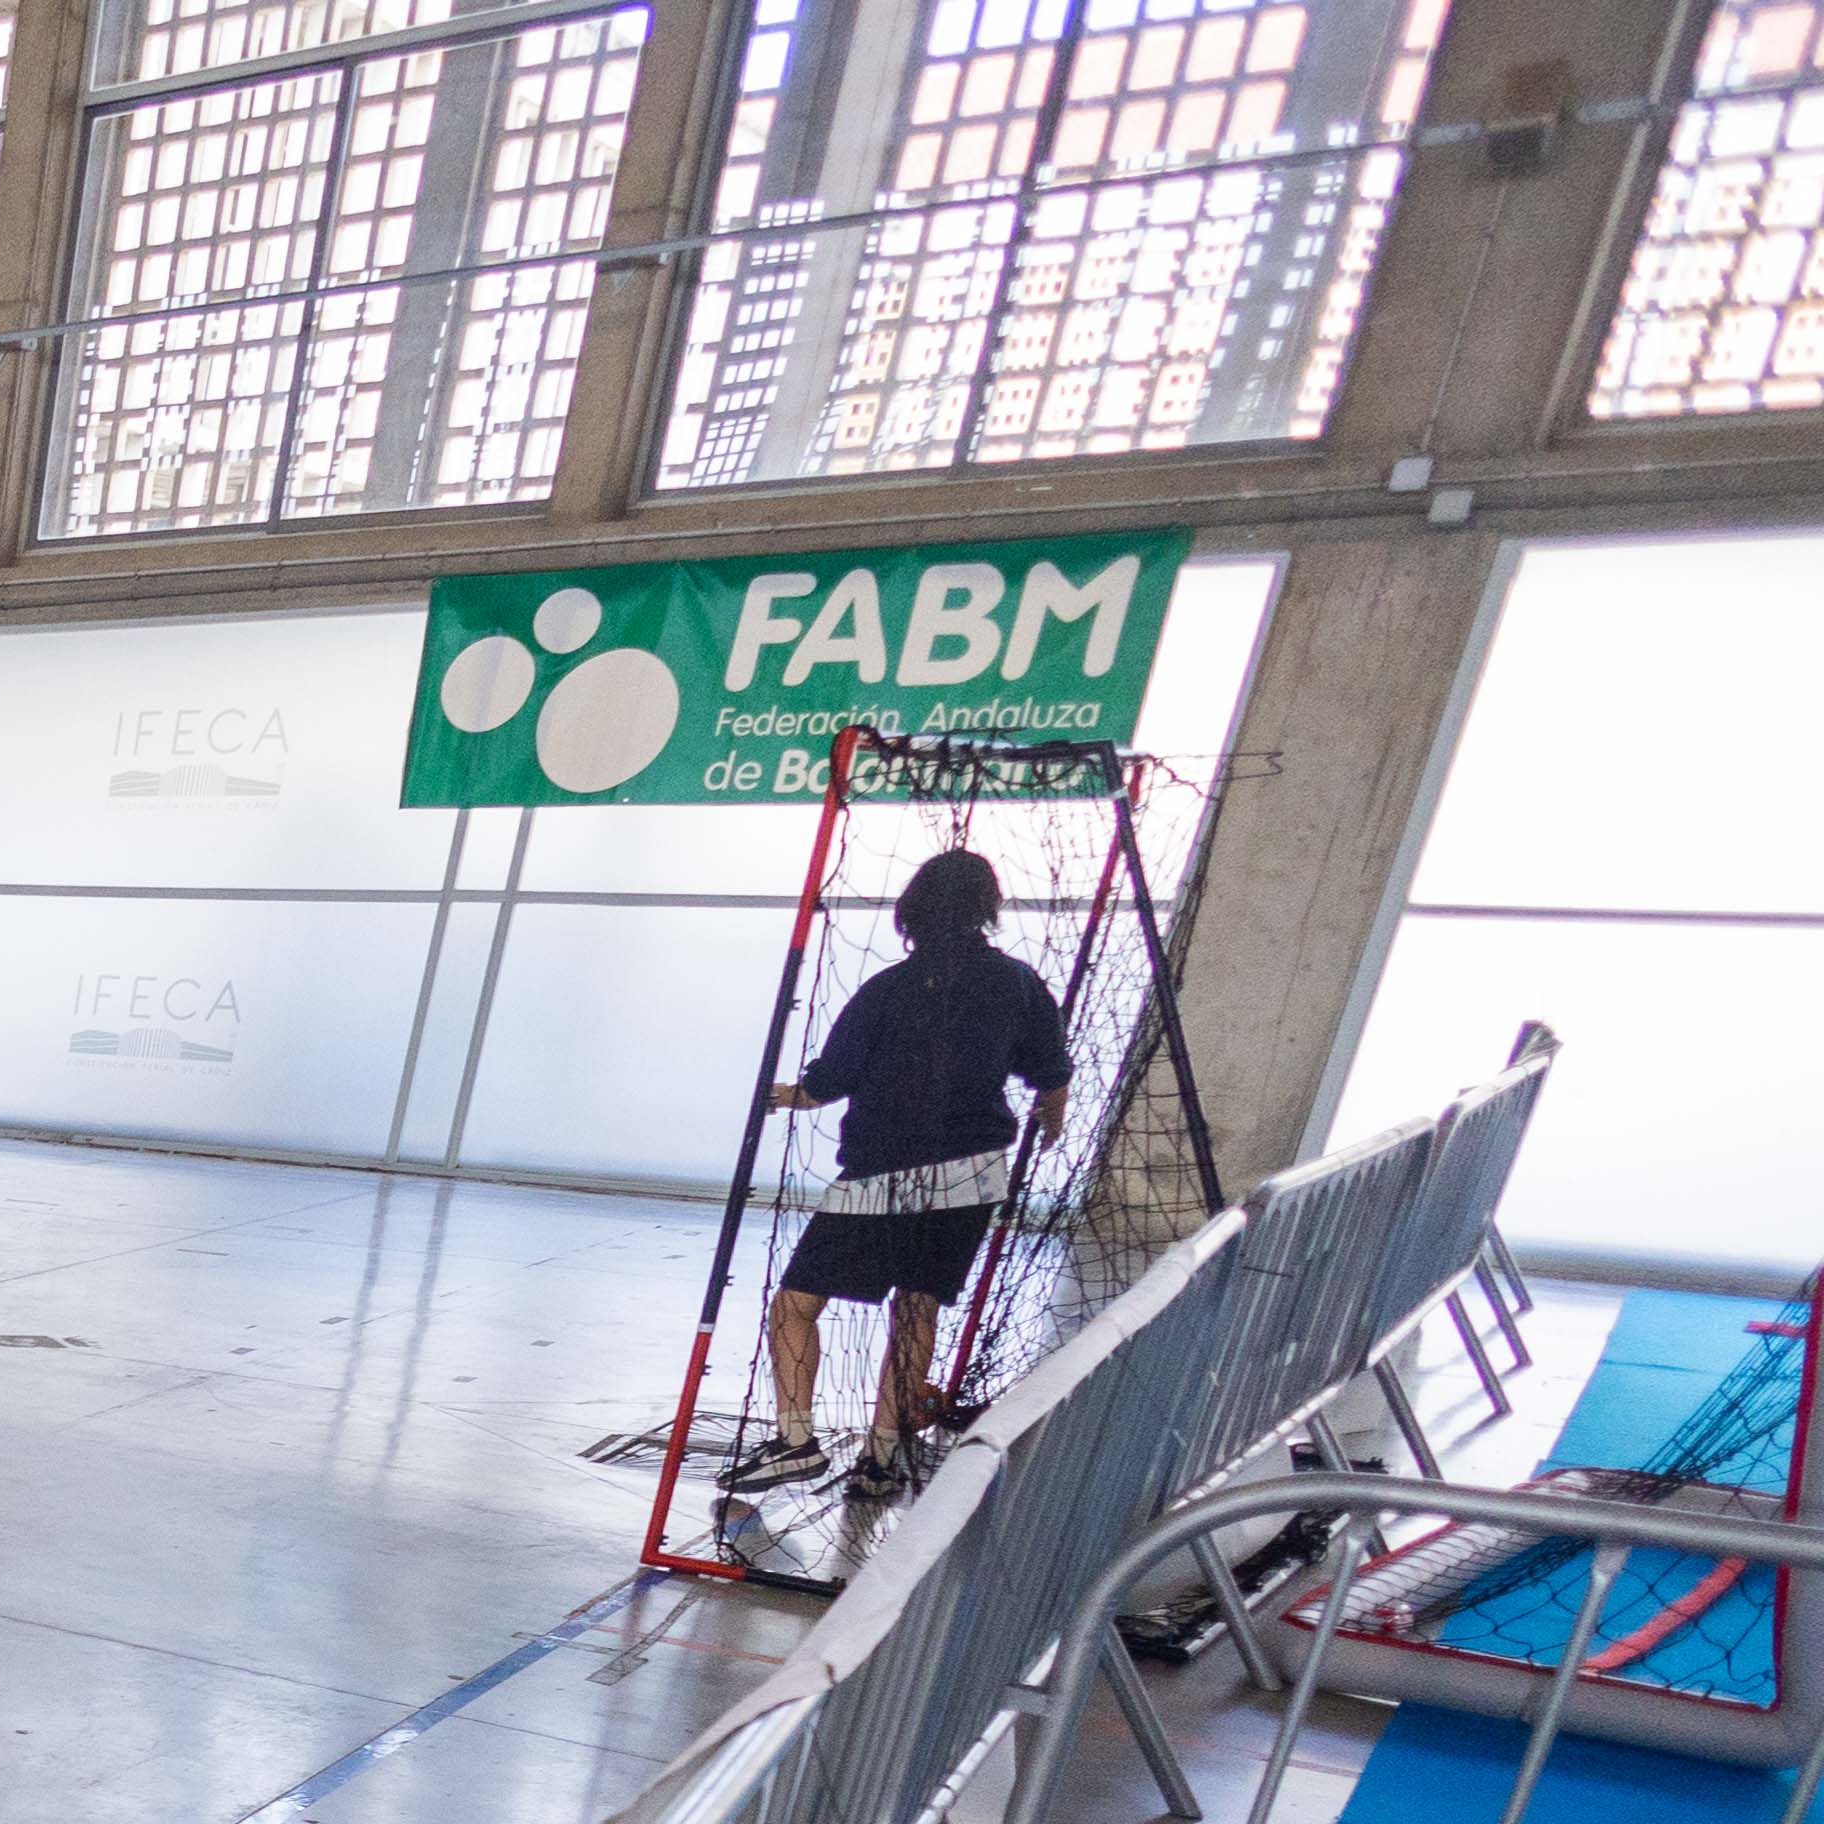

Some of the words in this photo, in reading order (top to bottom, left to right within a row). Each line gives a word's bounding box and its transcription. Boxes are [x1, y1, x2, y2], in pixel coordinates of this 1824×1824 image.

[724, 555, 1140, 692] FABM
[114, 707, 288, 756] IFECA
[715, 703, 900, 737] Federación
[921, 697, 1102, 734] Andaluza
[703, 749, 763, 792] de
[74, 974, 240, 1023] IFECA
